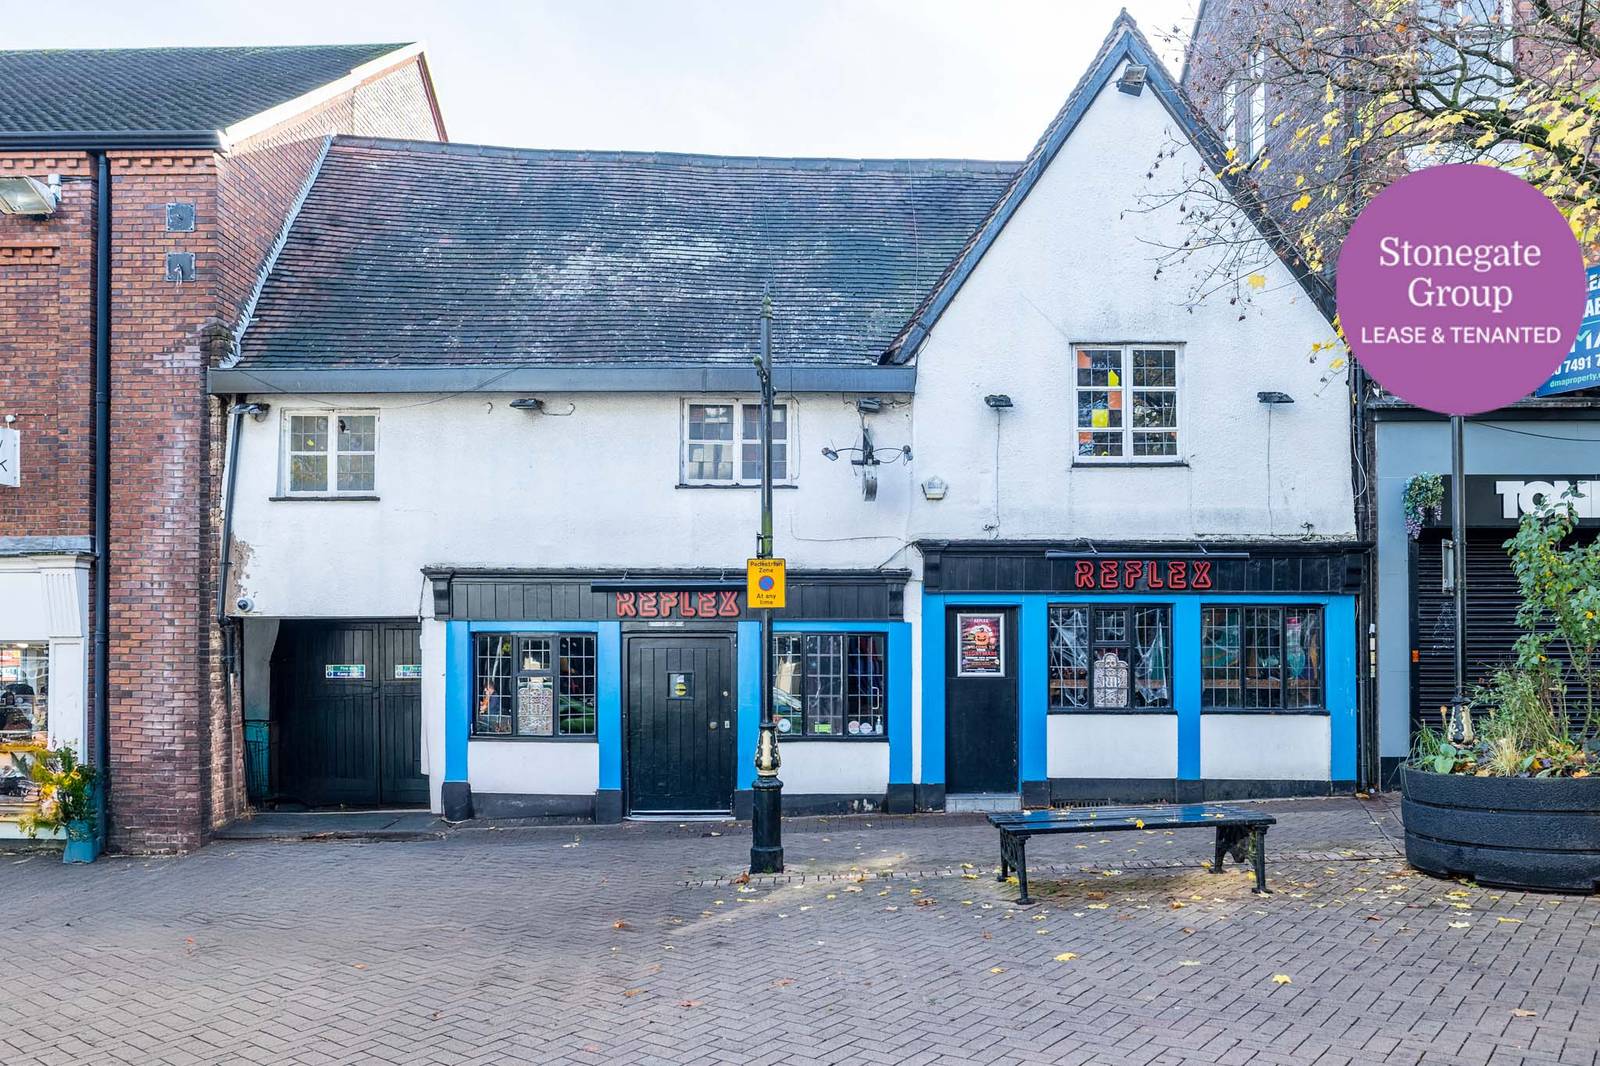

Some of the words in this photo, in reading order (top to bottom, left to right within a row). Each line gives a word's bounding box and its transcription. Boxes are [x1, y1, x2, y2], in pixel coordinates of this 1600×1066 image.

[1563, 355, 1592, 374] 7491
[1549, 373, 1600, 388] dmaproperty.
[1075, 560, 1212, 589] REFLEX
[616, 591, 740, 618] REFLEX
